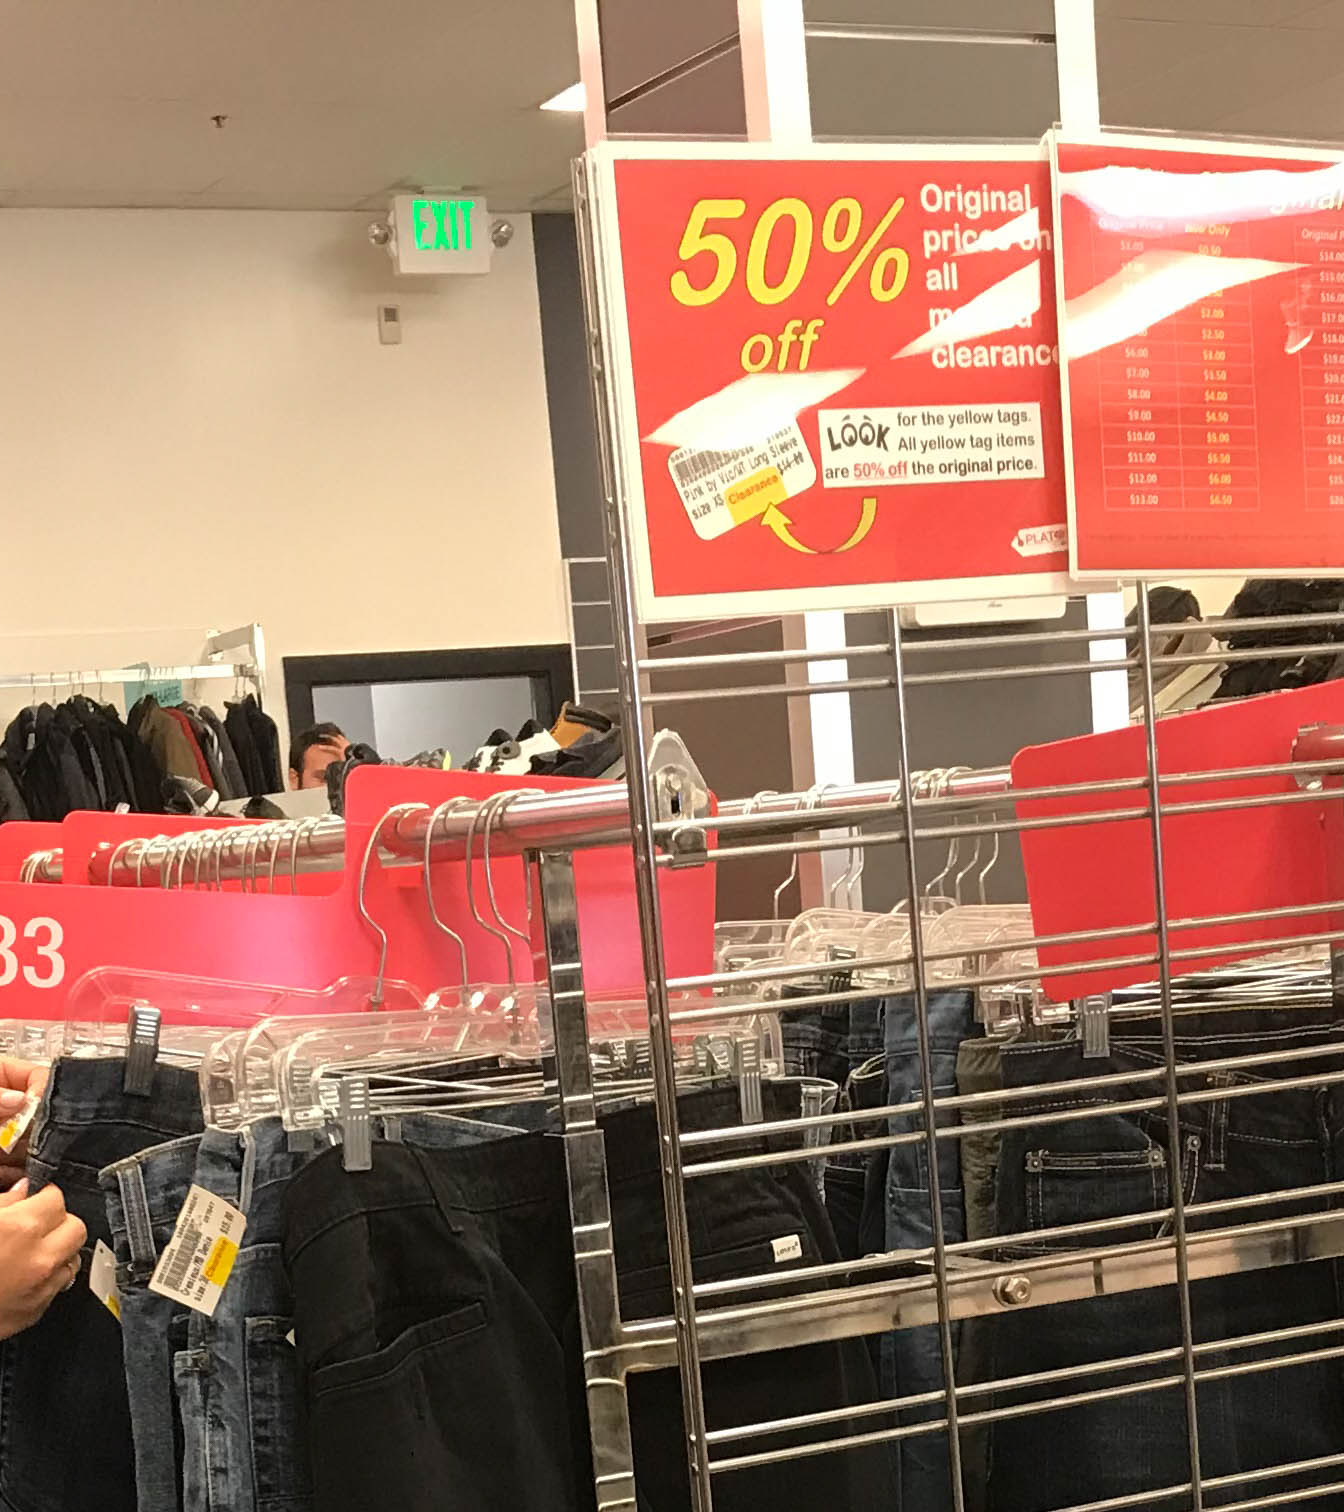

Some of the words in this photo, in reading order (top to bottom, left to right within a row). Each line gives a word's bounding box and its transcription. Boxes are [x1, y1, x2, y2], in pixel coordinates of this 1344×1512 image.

[412, 200, 475, 251] EXIT
[1302, 228, 1337, 243] Original
[669, 197, 910, 307] 50%
[920, 184, 1031, 218] Original
[925, 261, 958, 291] all
[740, 319, 825, 373] off
[897, 412, 916, 427] for
[921, 411, 945, 426] the
[947, 410, 993, 429] yellow
[997, 409, 1032, 426] tags.
[827, 420, 890, 451] LOOK
[898, 436, 916, 451] All
[920, 435, 966, 454] yellow
[969, 435, 993, 452] tag
[996, 432, 1035, 448] items
[683, 485, 704, 503] Pink
[706, 480, 718, 492] by
[748, 451, 769, 470] Long
[769, 437, 798, 458] Sleeve
[825, 466, 849, 479] are
[853, 462, 885, 478] 50%
[888, 460, 908, 477] off
[912, 460, 935, 475] the
[938, 458, 993, 477] original
[997, 456, 1038, 475] price.
[727, 474, 779, 505] Clearance
[691, 503, 711, 520] size
